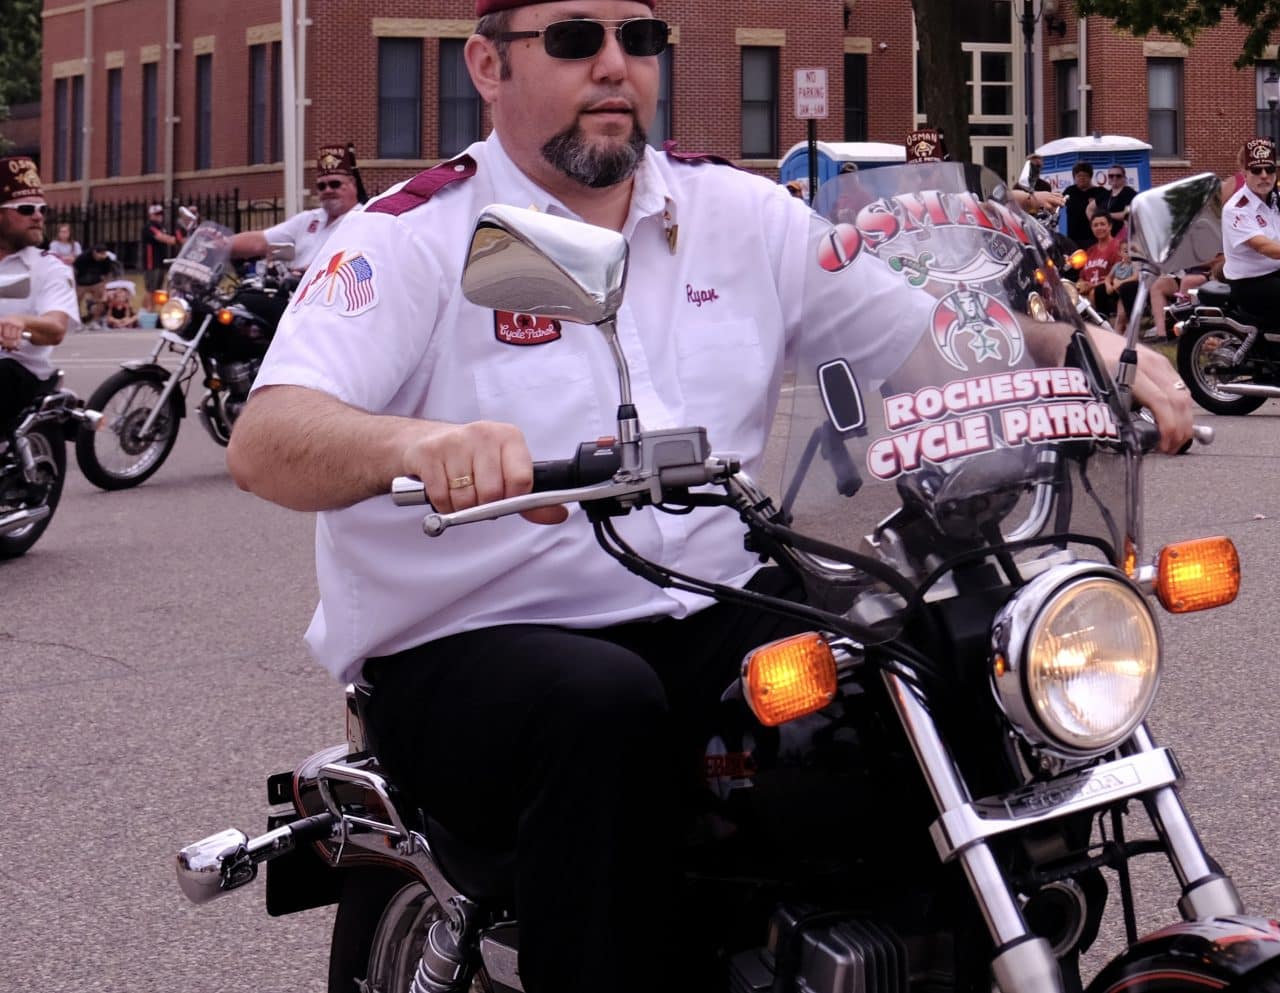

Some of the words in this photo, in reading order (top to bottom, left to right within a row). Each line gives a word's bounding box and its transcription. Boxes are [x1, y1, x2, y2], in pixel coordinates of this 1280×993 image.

[805, 72, 816, 83] NO
[799, 87, 824, 99] PARKING
[906, 133, 937, 146] OSMAN
[817, 190, 1031, 272] OSMAN
[686, 283, 720, 308] Ryan
[499, 324, 525, 341] Cycle
[885, 368, 1092, 431] ROCHESTER
[868, 414, 992, 479] CYCLE
[1001, 402, 1119, 445] PATROL
